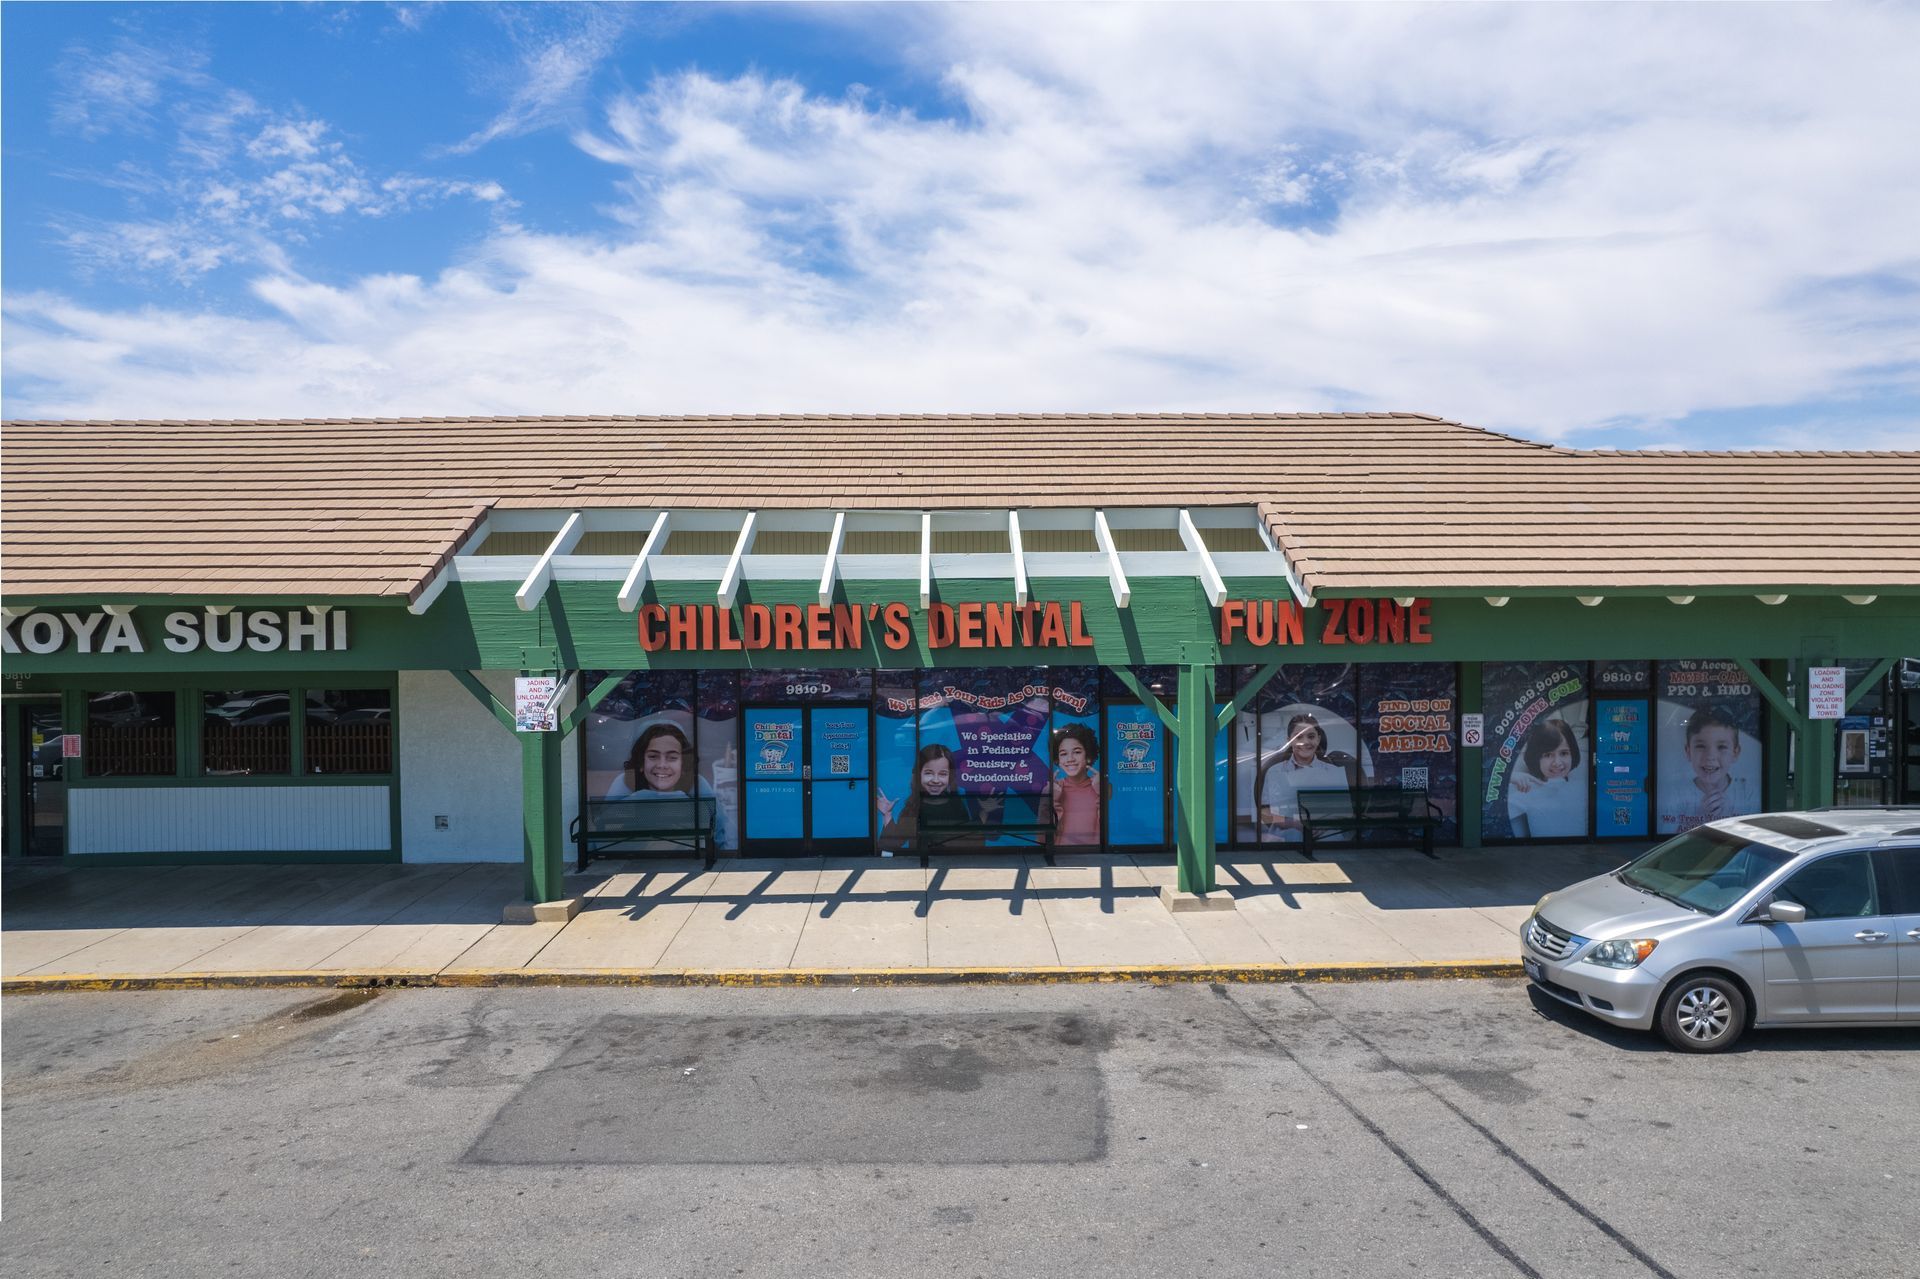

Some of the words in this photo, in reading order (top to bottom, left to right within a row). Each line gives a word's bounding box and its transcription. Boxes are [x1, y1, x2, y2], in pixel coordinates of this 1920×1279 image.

[638, 602, 910, 651] CHILDREN'S
[927, 601, 1094, 650] DENTAL
[1220, 599, 1304, 646] FUN
[1322, 598, 1432, 645] ZONE
[163, 610, 347, 652] SUSHI
[1680, 661, 1697, 670] We
[1602, 672, 1631, 682] 9810
[1635, 671, 1644, 682] C
[1670, 671, 1751, 684] MEDI-CAL
[16, 681, 23, 689] E
[786, 684, 818, 695] 9810
[822, 684, 831, 693] D
[1667, 685, 1697, 696] PPO
[1702, 686, 1712, 697] &
[1717, 685, 1751, 695] HMO
[888, 698, 907, 712] We
[944, 686, 977, 704] Your
[977, 695, 1006, 709] Kids
[1008, 693, 1025, 705] As
[1023, 685, 1050, 698] Our
[1053, 687, 1087, 712] Own!
[1495, 670, 1568, 735] 909.429.9090
[1378, 700, 1410, 713] FIND
[1411, 700, 1430, 712] US
[1430, 699, 1451, 712] ON
[1379, 715, 1450, 733] SOCIAL
[755, 730, 794, 740] Dental
[961, 732, 978, 741] We
[980, 732, 1032, 743] Specialize
[1118, 730, 1155, 740] Dental
[1378, 734, 1451, 752] MEDIA
[968, 745, 978, 755] in
[982, 745, 1030, 755] Pediatric
[966, 759, 1016, 770] Dentistry
[1020, 760, 1027, 768] &
[961, 772, 1033, 783] Orthodontics!
